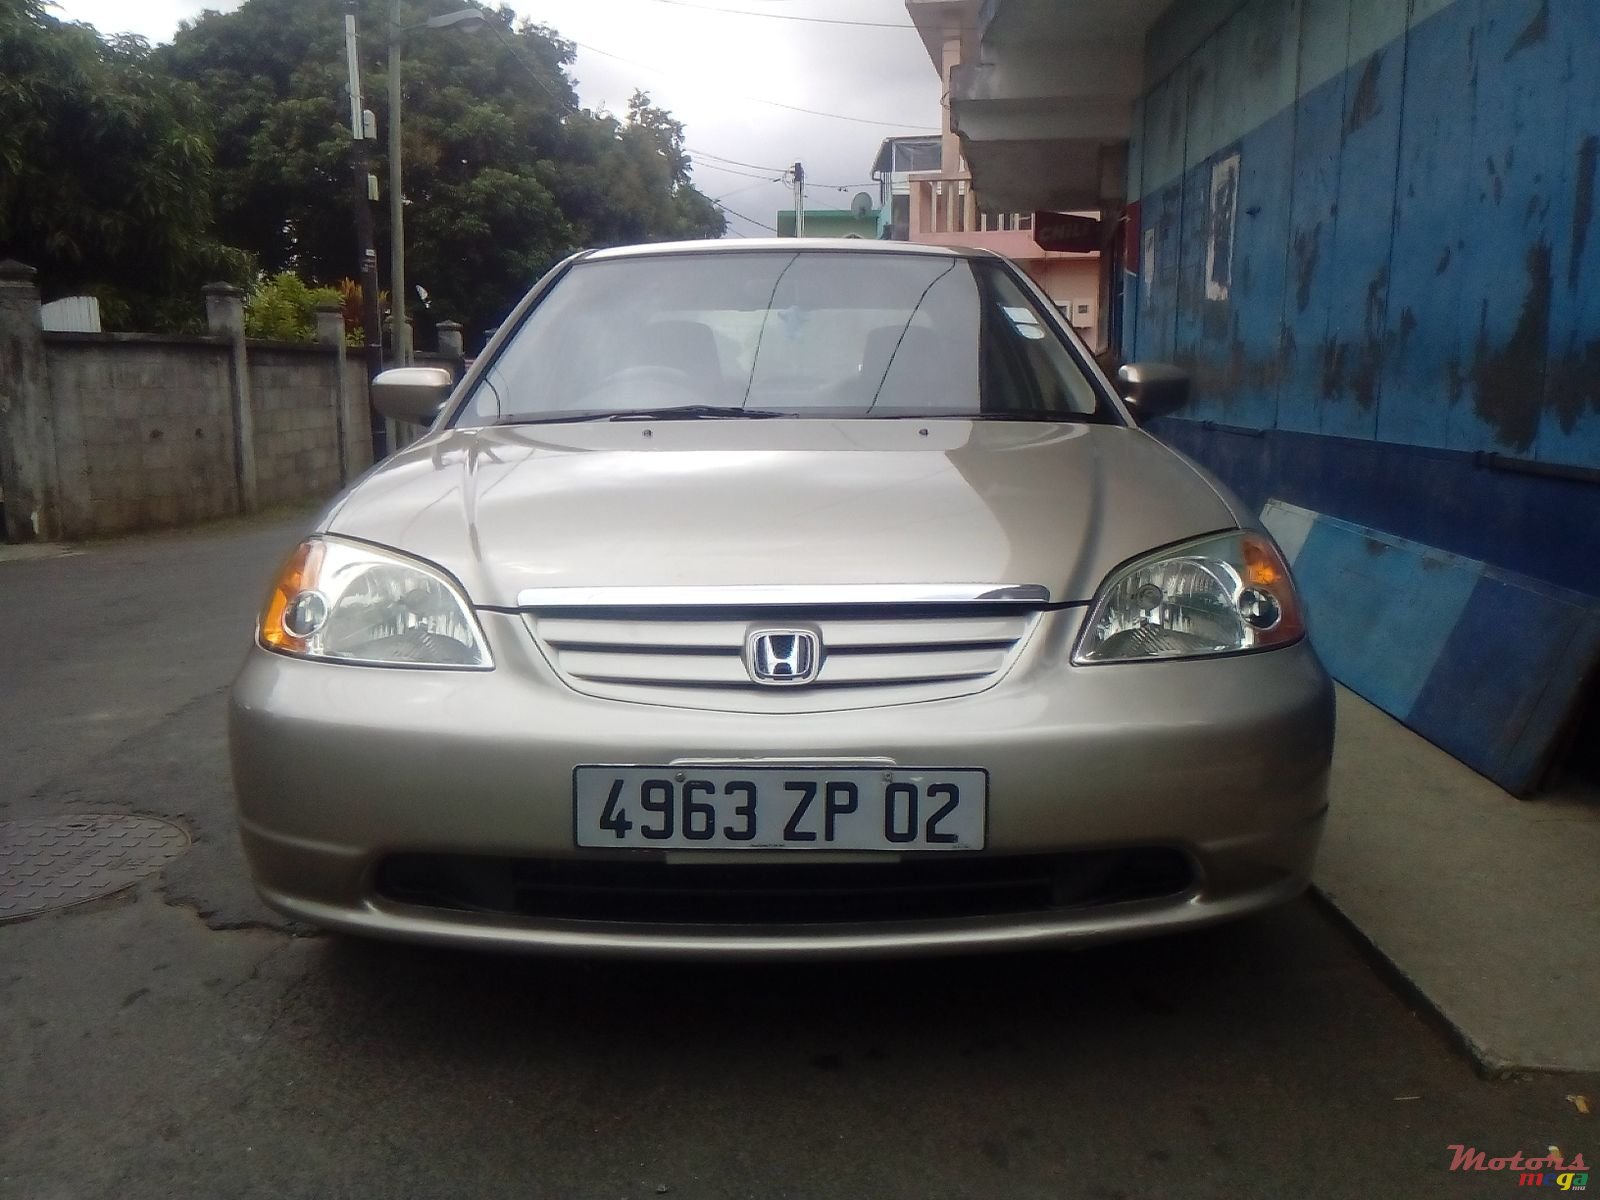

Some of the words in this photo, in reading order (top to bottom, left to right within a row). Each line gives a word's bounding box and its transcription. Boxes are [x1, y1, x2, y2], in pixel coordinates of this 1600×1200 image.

[599, 779, 757, 841] 4963
[783, 781, 859, 842] ZP
[884, 782, 960, 844] 02
